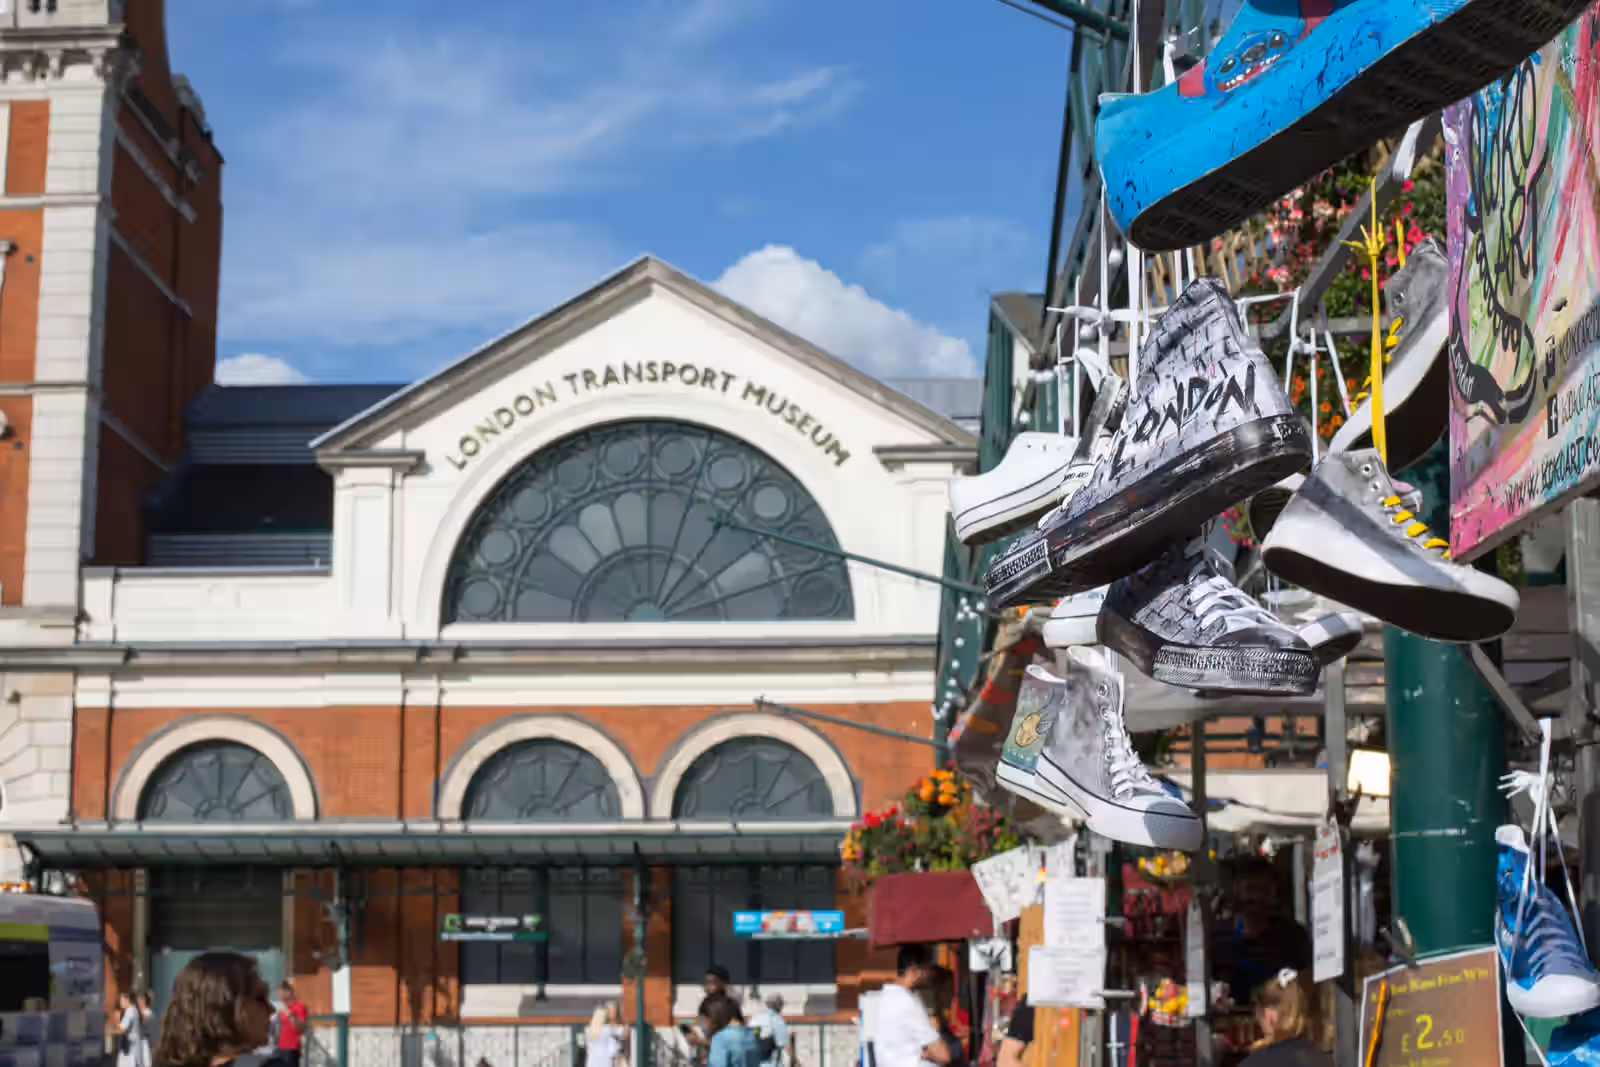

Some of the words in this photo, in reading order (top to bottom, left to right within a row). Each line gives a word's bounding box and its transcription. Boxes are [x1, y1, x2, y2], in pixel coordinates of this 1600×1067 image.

[446, 381, 557, 472] LONDON
[563, 360, 736, 396] TRANSPORT
[741, 380, 851, 467] MUSEUM
[1110, 359, 1261, 480] LONDON
